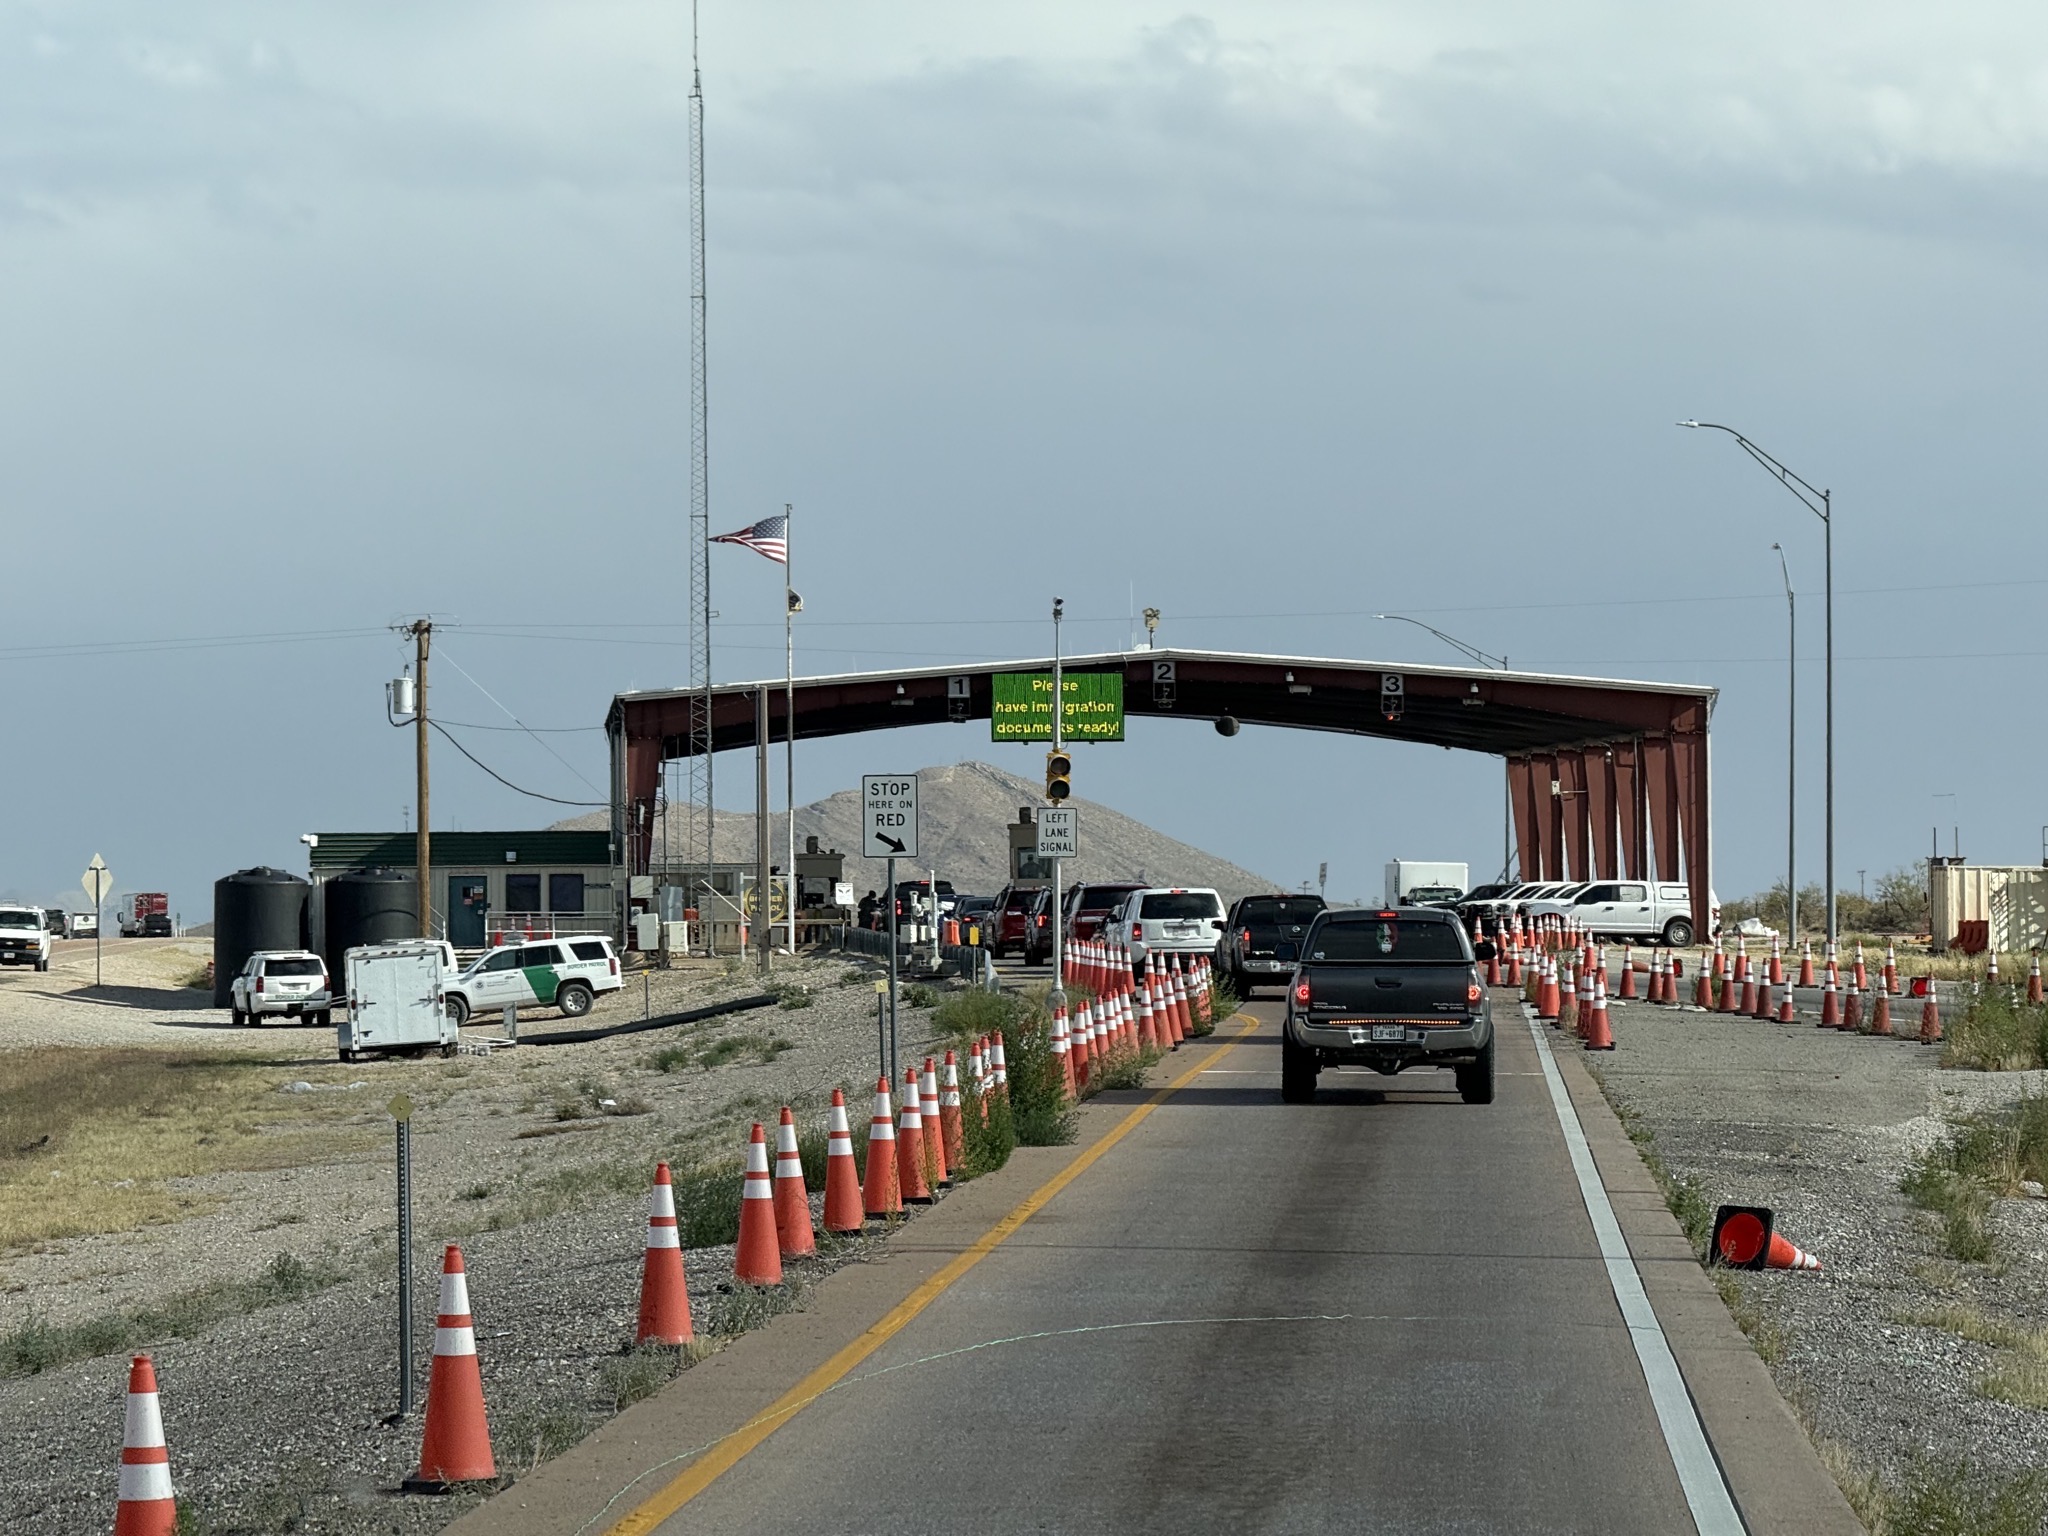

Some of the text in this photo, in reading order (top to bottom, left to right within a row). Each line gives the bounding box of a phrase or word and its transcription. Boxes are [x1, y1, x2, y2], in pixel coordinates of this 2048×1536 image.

[1157, 663, 1171, 680] 2
[954, 678, 964, 695] 1
[1032, 679, 1079, 692] Plese
[1385, 676, 1400, 693] 3
[995, 701, 1028, 713] have
[996, 721, 1074, 734] documets
[870, 782, 910, 796] STOP
[868, 800, 913, 809] HERE ON
[876, 813, 905, 827] RED
[1045, 813, 1069, 823] LEFT
[1045, 828, 1069, 837] LANE
[1040, 842, 1074, 852] SIGNAL
